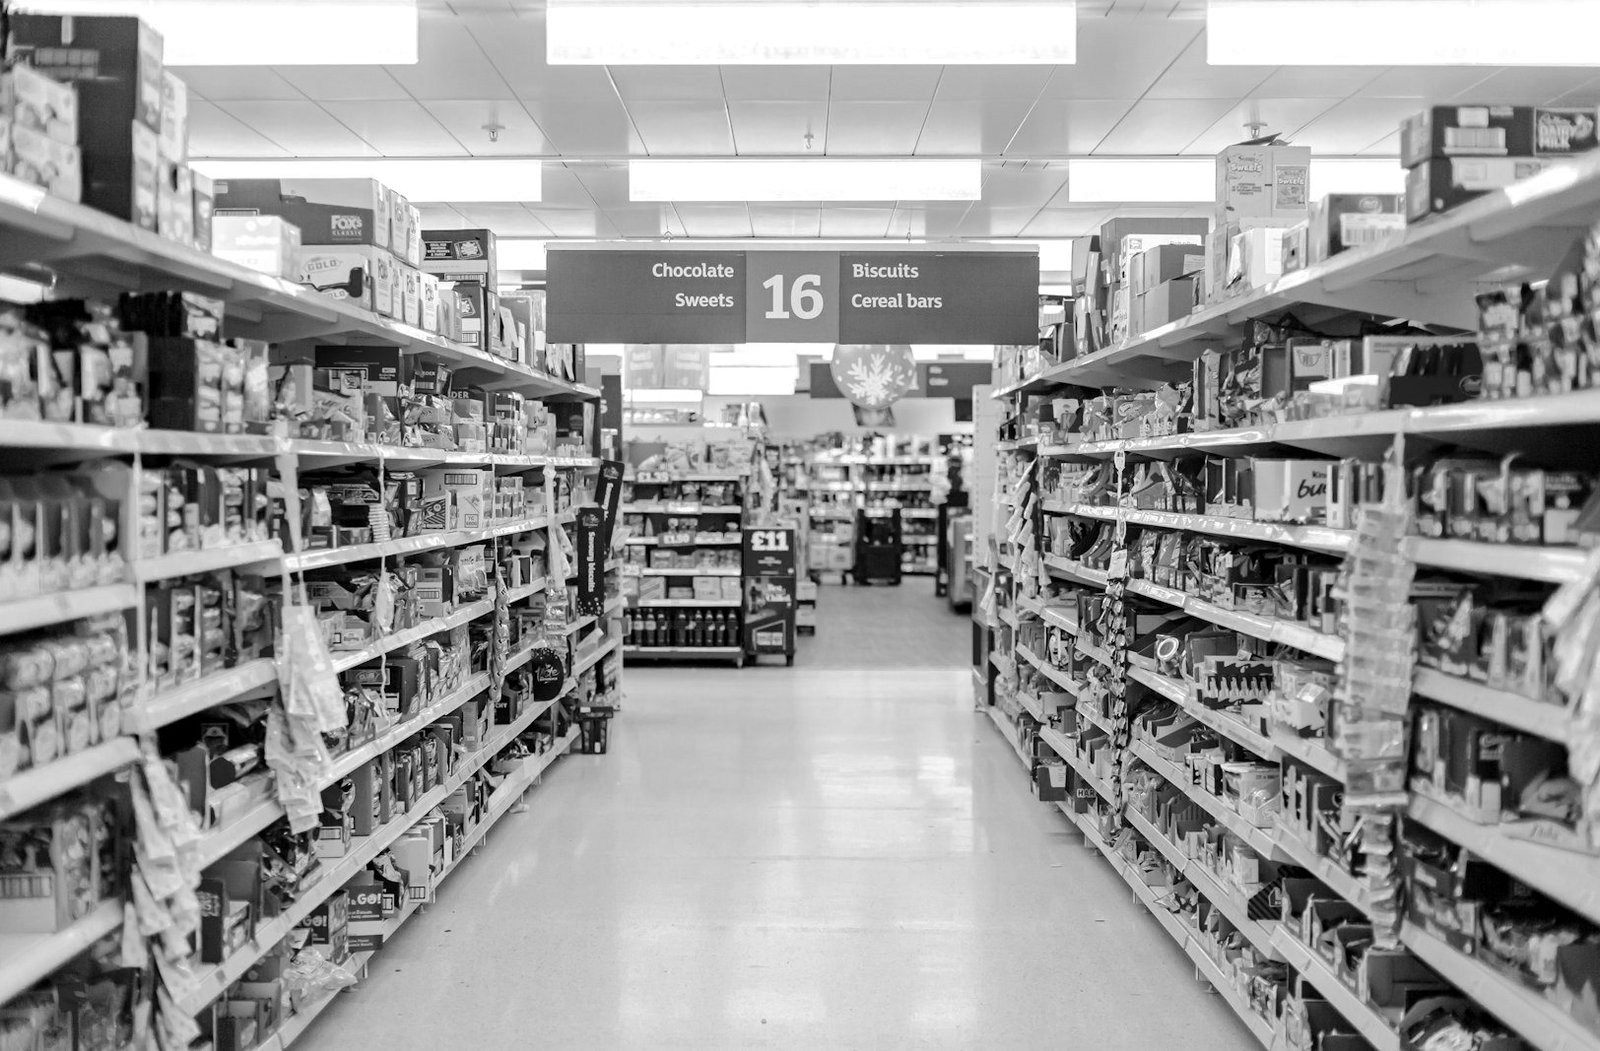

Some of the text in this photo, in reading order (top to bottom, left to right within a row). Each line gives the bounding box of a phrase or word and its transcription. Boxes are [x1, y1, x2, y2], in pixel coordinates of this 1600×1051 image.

[308, 259, 337, 271] GOLD
[651, 262, 735, 279] Chocolate
[852, 263, 920, 279] Biscuits
[675, 292, 735, 308] Sweets
[762, 274, 824, 320] 16
[851, 293, 944, 310] Cereal bars
[751, 530, 789, 551] £11
[587, 531, 596, 593] Savoury biscuits
[357, 893, 381, 905] GO!
